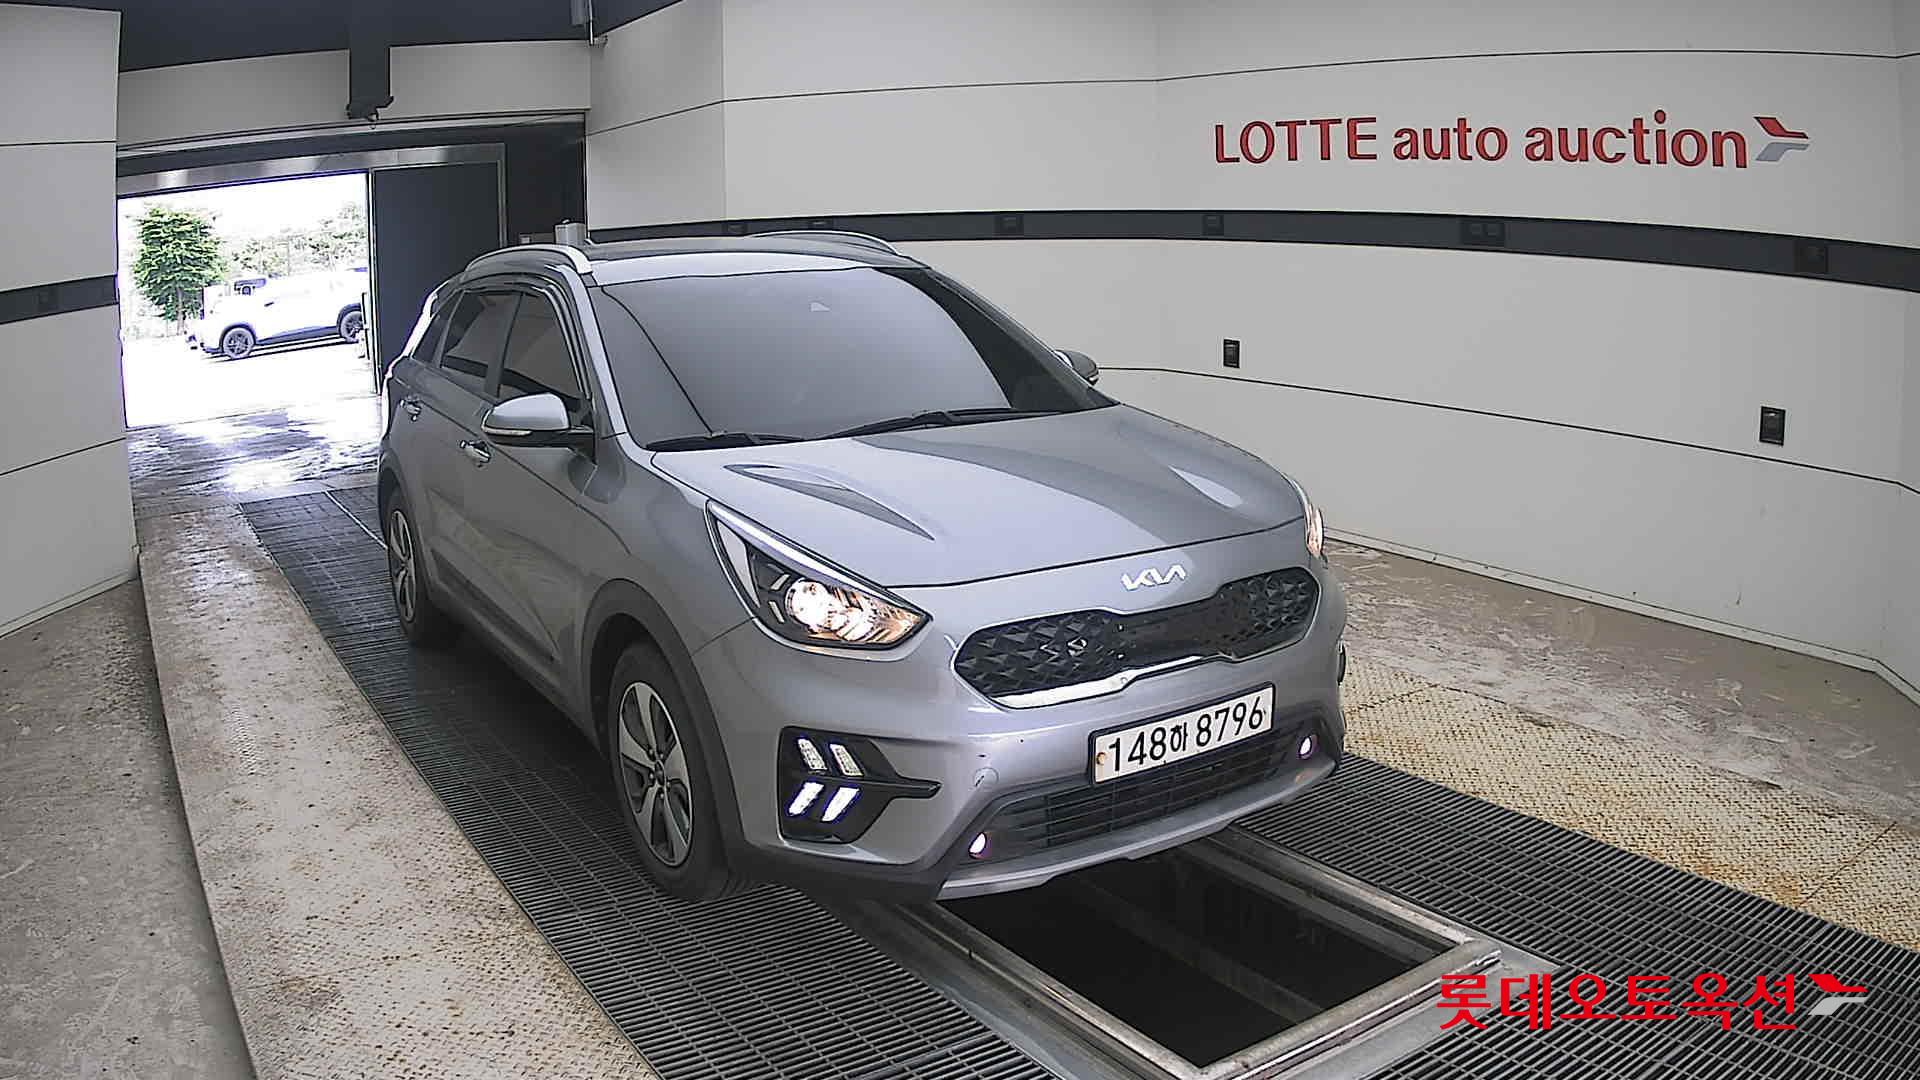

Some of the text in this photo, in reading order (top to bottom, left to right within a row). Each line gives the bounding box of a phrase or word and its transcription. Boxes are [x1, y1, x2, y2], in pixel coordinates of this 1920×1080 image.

[1214, 110, 1748, 169] LOTTE auto auction
[1108, 696, 1263, 772] 148하 8796
